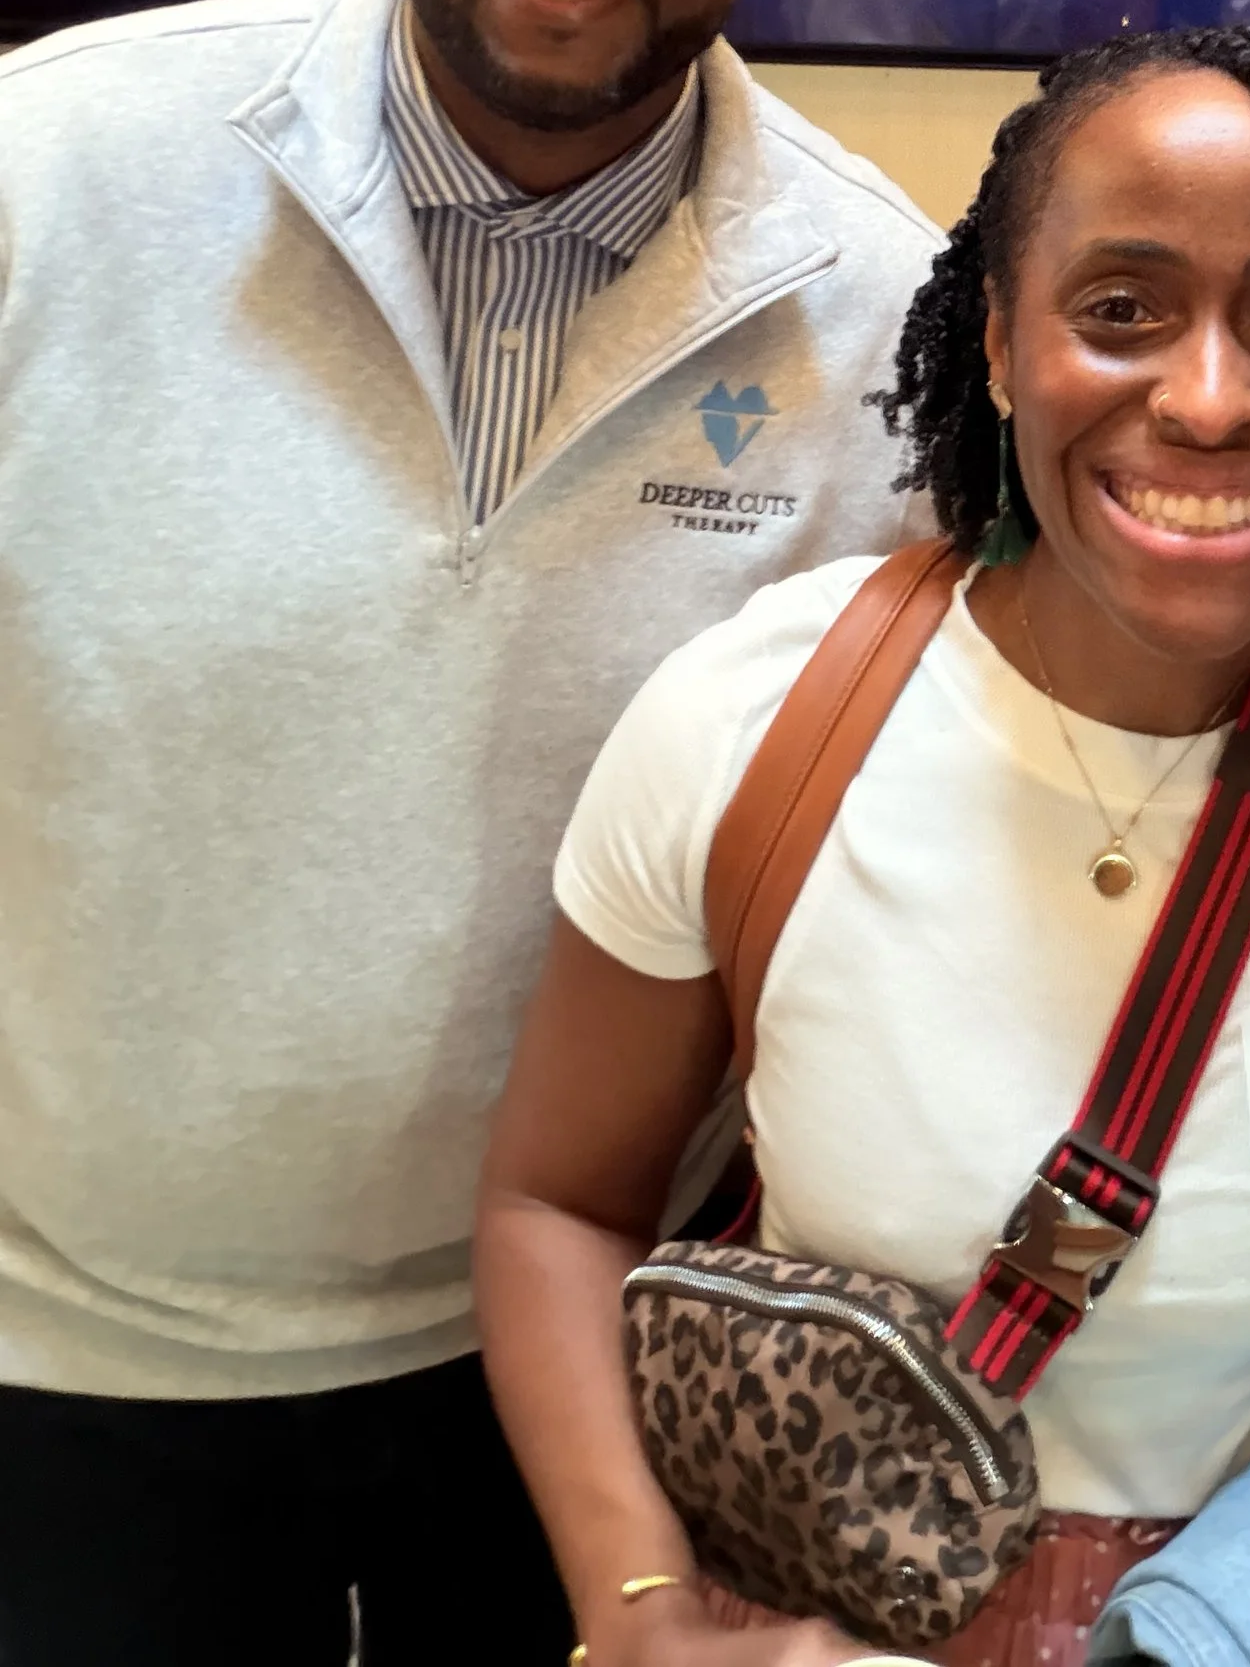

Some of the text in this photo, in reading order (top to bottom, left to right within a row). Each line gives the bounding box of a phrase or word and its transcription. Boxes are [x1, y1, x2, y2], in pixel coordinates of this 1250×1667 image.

[640, 482, 797, 517] DEEPER CUTS
[672, 514, 759, 536] THERAPY
